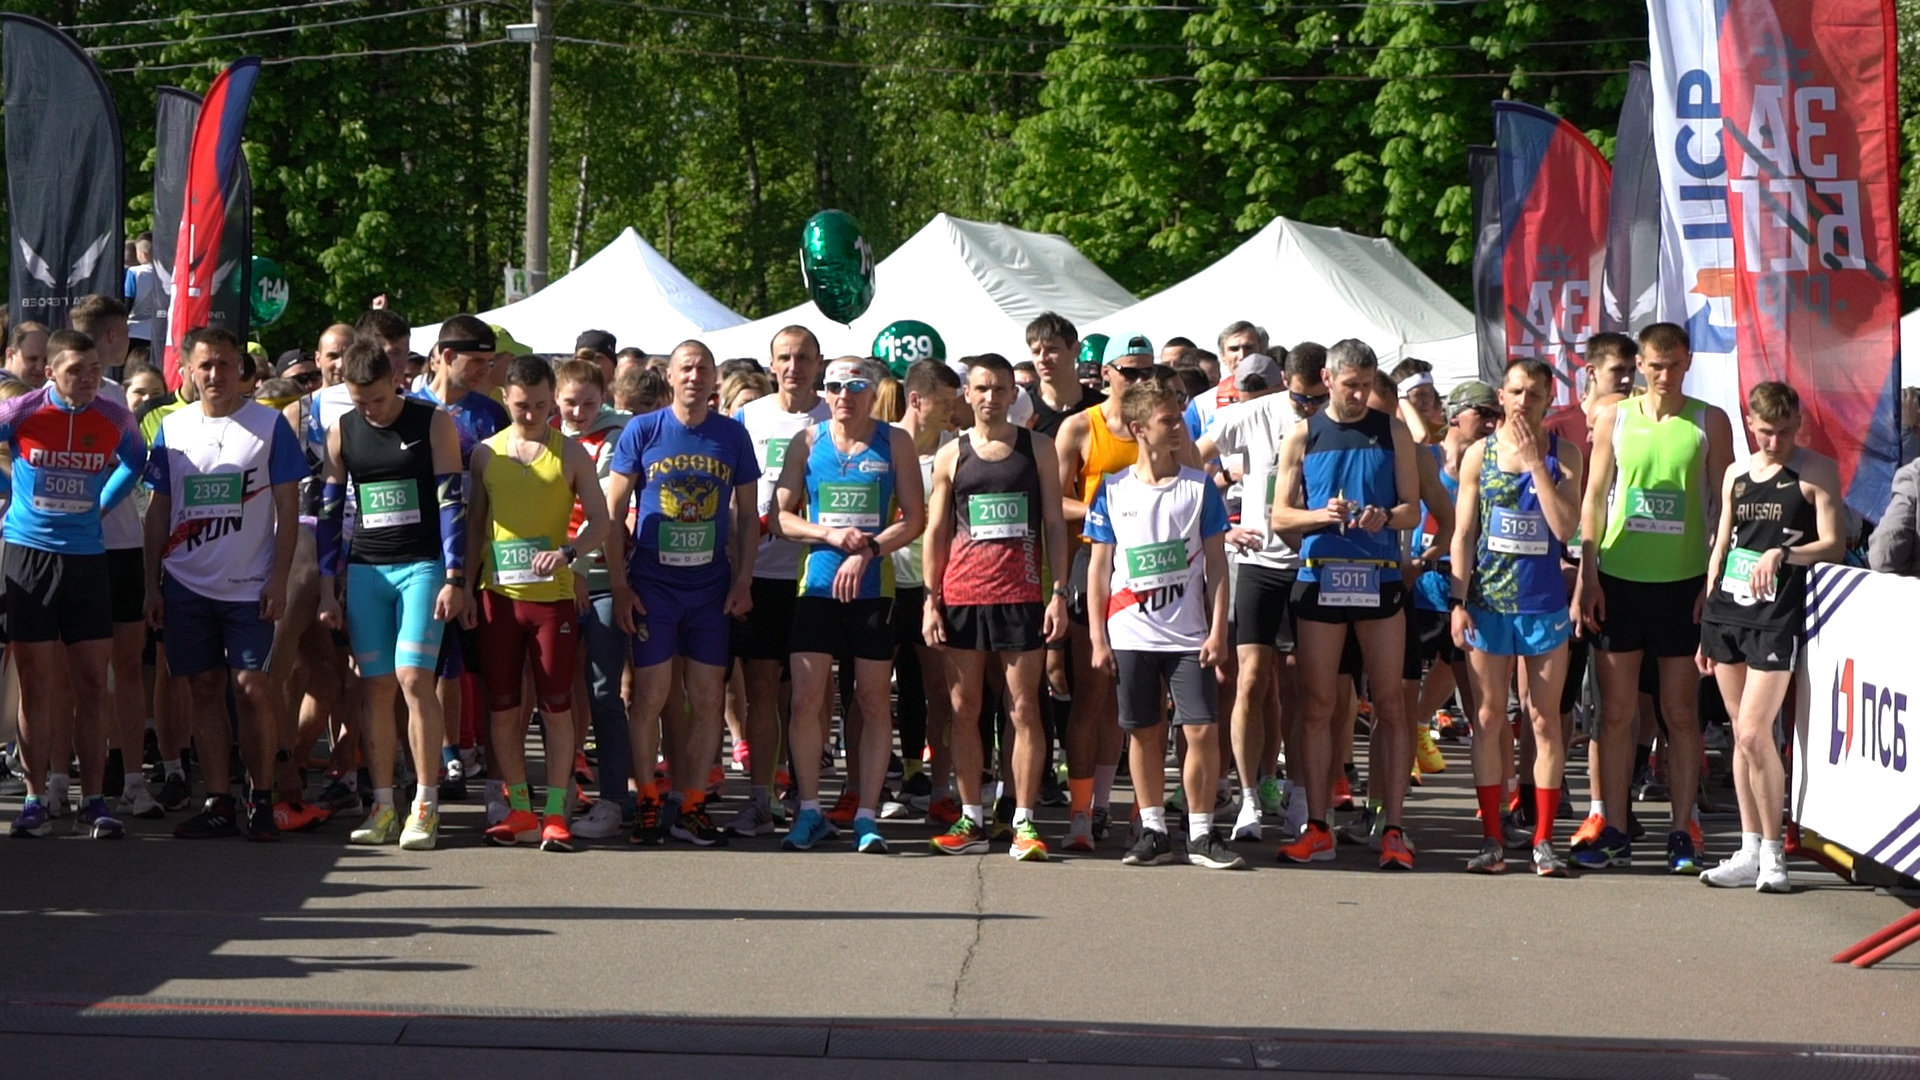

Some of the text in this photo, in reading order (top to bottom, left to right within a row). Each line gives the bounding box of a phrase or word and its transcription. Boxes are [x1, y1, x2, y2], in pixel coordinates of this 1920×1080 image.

[879, 335, 933, 362] 1:39
[30, 448, 105, 471] RUSSIA
[648, 454, 731, 485] РОССИЯ
[45, 476, 85, 496] 5081
[192, 483, 231, 500] 2392
[369, 489, 407, 508] 2158
[830, 492, 868, 508] 2372
[1634, 497, 1675, 515] 2032
[979, 502, 1019, 520] 2100
[1736, 503, 1783, 520] RUSSIA
[1501, 518, 1538, 536] 5193
[669, 531, 706, 548] 2187
[1136, 551, 1178, 571] 2344
[1331, 571, 1367, 588] 5011
[1862, 681, 1908, 773] ПСБ
